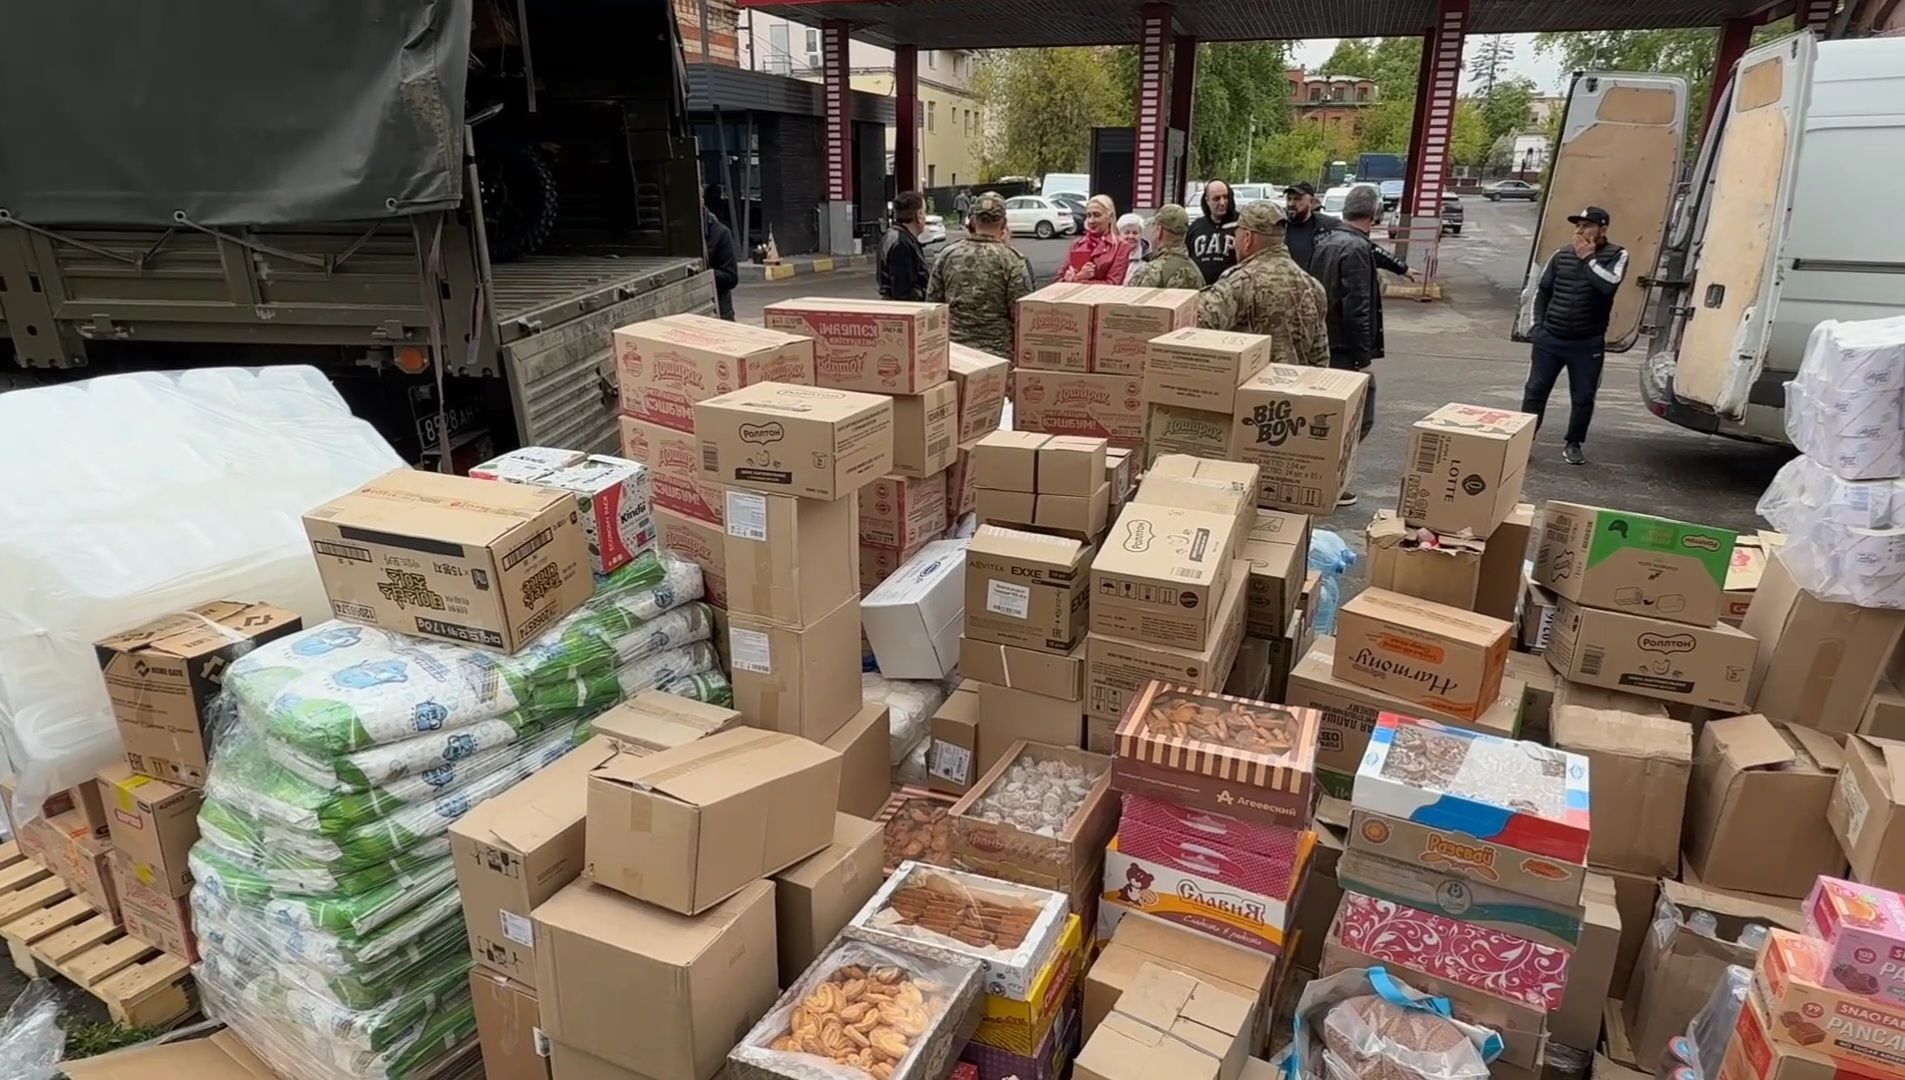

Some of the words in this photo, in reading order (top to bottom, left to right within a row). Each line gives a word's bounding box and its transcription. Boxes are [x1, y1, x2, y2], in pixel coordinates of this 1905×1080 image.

[1194, 232, 1236, 257] GAP
[1253, 400, 1293, 423] BiG
[743, 429, 781, 439] Роллтон
[1245, 417, 1306, 446] BON
[1444, 459, 1462, 504] LOTTE
[1011, 566, 1044, 579] EXXE
[1642, 638, 1692, 648] Роллтон
[1353, 647, 1458, 696] Harmony
[1236, 796, 1297, 818] Агеевский
[1429, 833, 1494, 866] Разевай
[1825, 1015, 1905, 1052] PANCA
